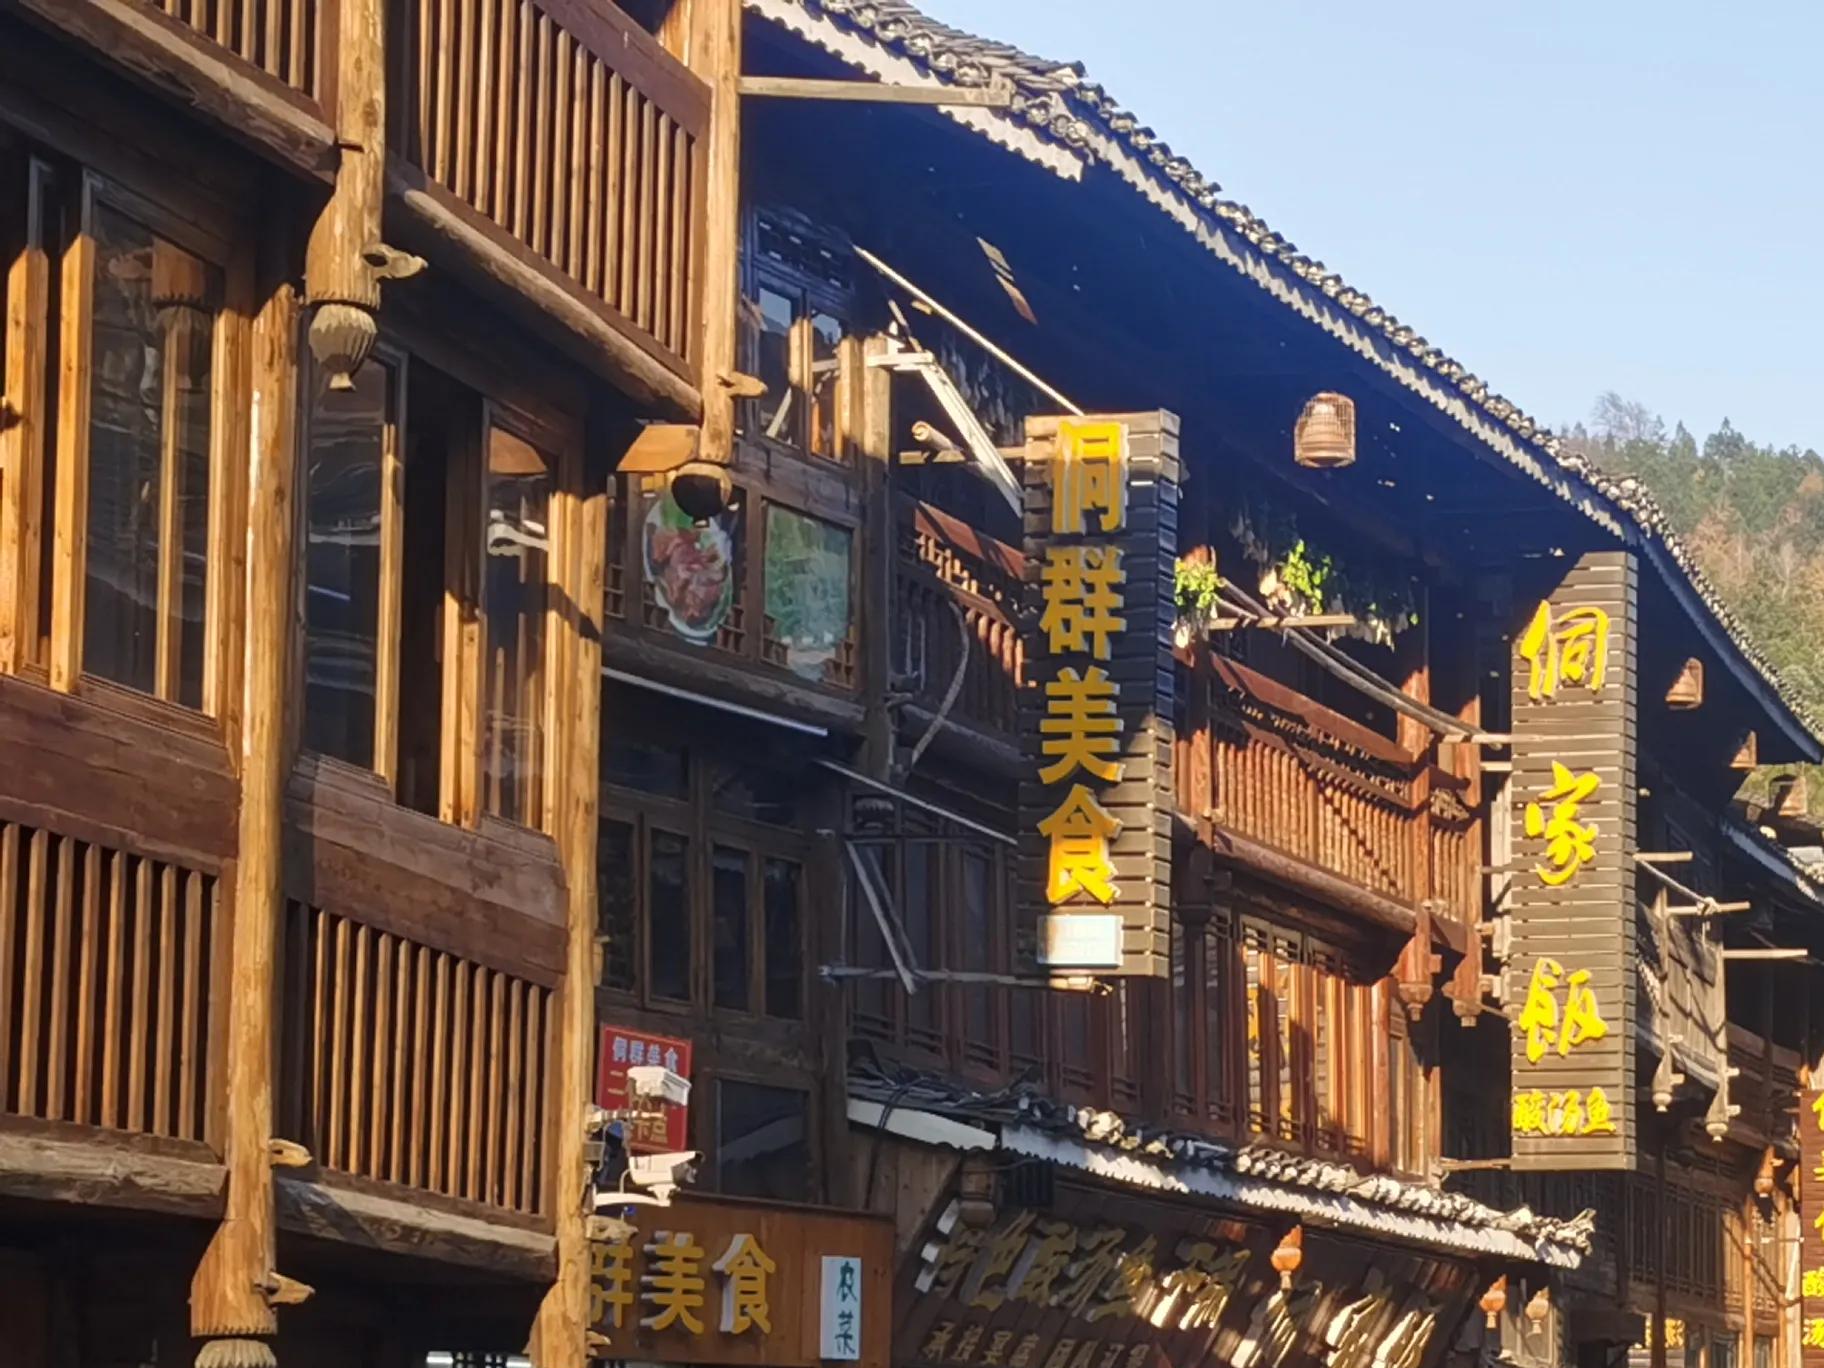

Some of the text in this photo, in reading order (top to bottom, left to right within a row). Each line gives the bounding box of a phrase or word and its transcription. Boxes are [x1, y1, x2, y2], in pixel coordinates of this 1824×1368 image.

[1038, 419, 1128, 905] 侗群美食
[1512, 1085, 1618, 1135] 酸汤鱼
